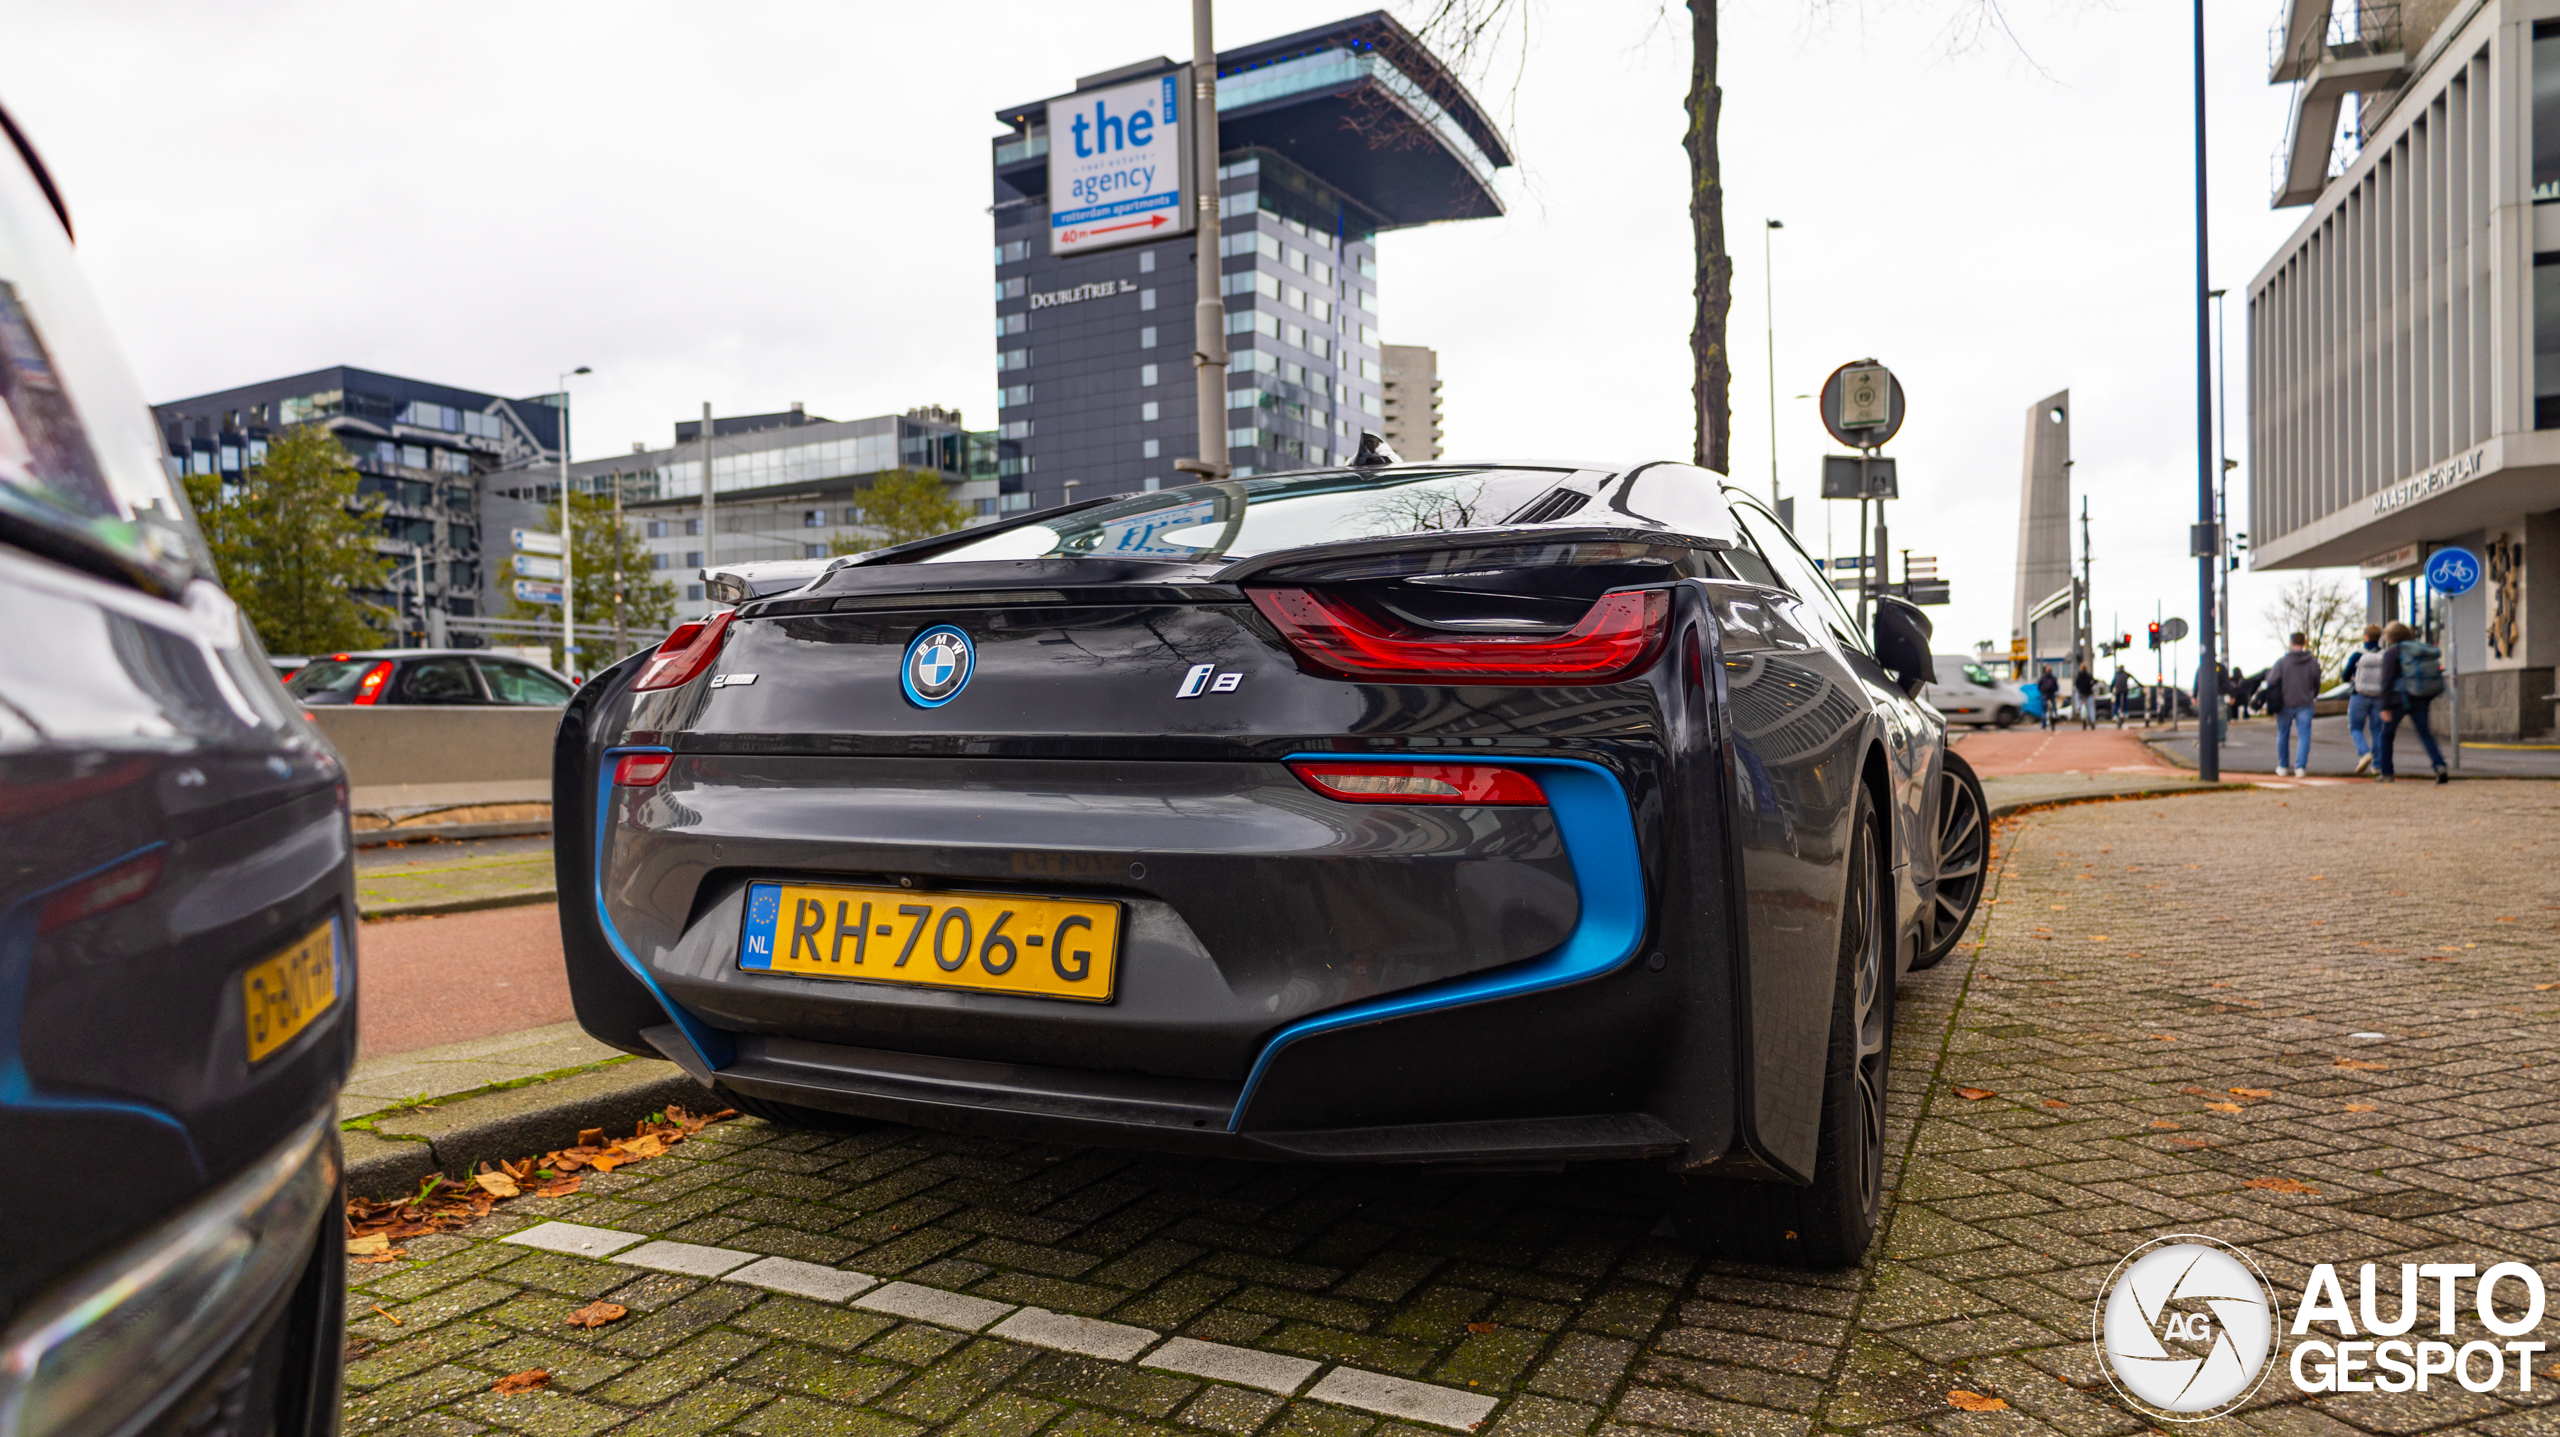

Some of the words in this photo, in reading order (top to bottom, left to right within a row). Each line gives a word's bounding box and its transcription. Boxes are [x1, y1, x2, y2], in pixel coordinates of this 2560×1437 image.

[1071, 100, 1154, 158] the
[1080, 161, 1104, 173] real
[1109, 153, 1147, 167] estate
[1072, 165, 1156, 204] agency
[1061, 206, 1111, 223] rotterdam
[1113, 195, 1170, 217] apartments
[1061, 229, 1078, 244] 40
[2372, 450, 2483, 516] MAASTORENFLAT
[918, 634, 965, 656] BMW
[1175, 663, 1244, 699] i8
[748, 934, 769, 955] NL
[790, 898, 1092, 982] RH-706-G
